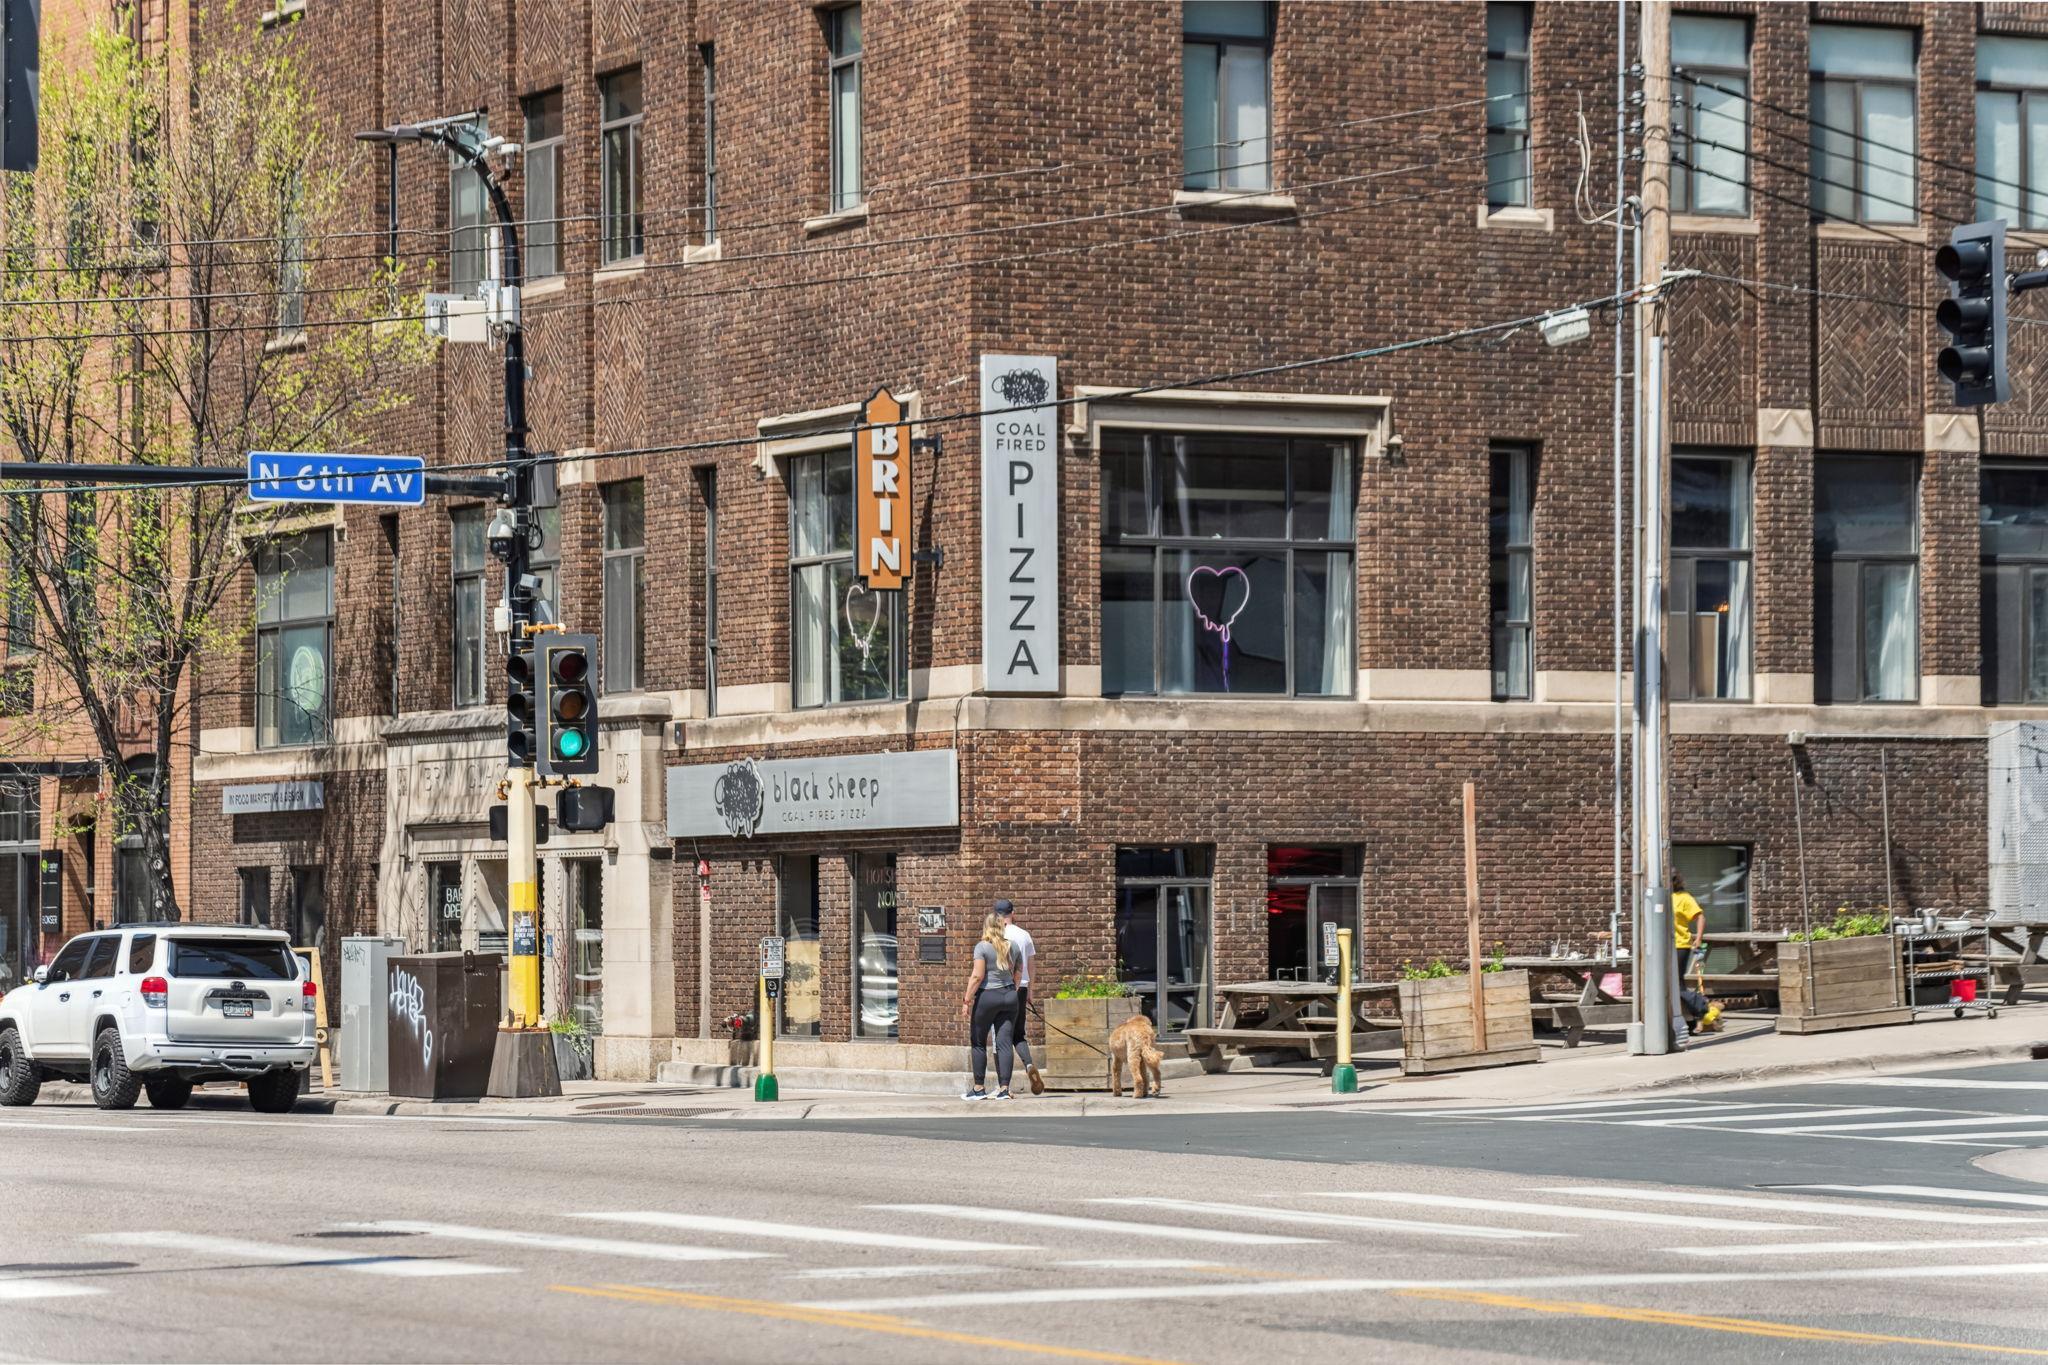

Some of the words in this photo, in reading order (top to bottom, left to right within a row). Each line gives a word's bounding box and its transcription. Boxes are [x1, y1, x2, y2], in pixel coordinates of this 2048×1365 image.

[996, 422, 1046, 436] COAL
[996, 438, 1046, 451] FIRED
[259, 462, 280, 490] N
[296, 464, 354, 492] 6th
[370, 466, 413, 494] Av
[871, 421, 900, 571] BRIN
[1007, 459, 1040, 676] PIZZA
[773, 771, 820, 803] black
[828, 772, 880, 808] sheep
[782, 811, 805, 822] COAL
[809, 809, 836, 821] FIRED
[841, 808, 867, 820] PIZZA
